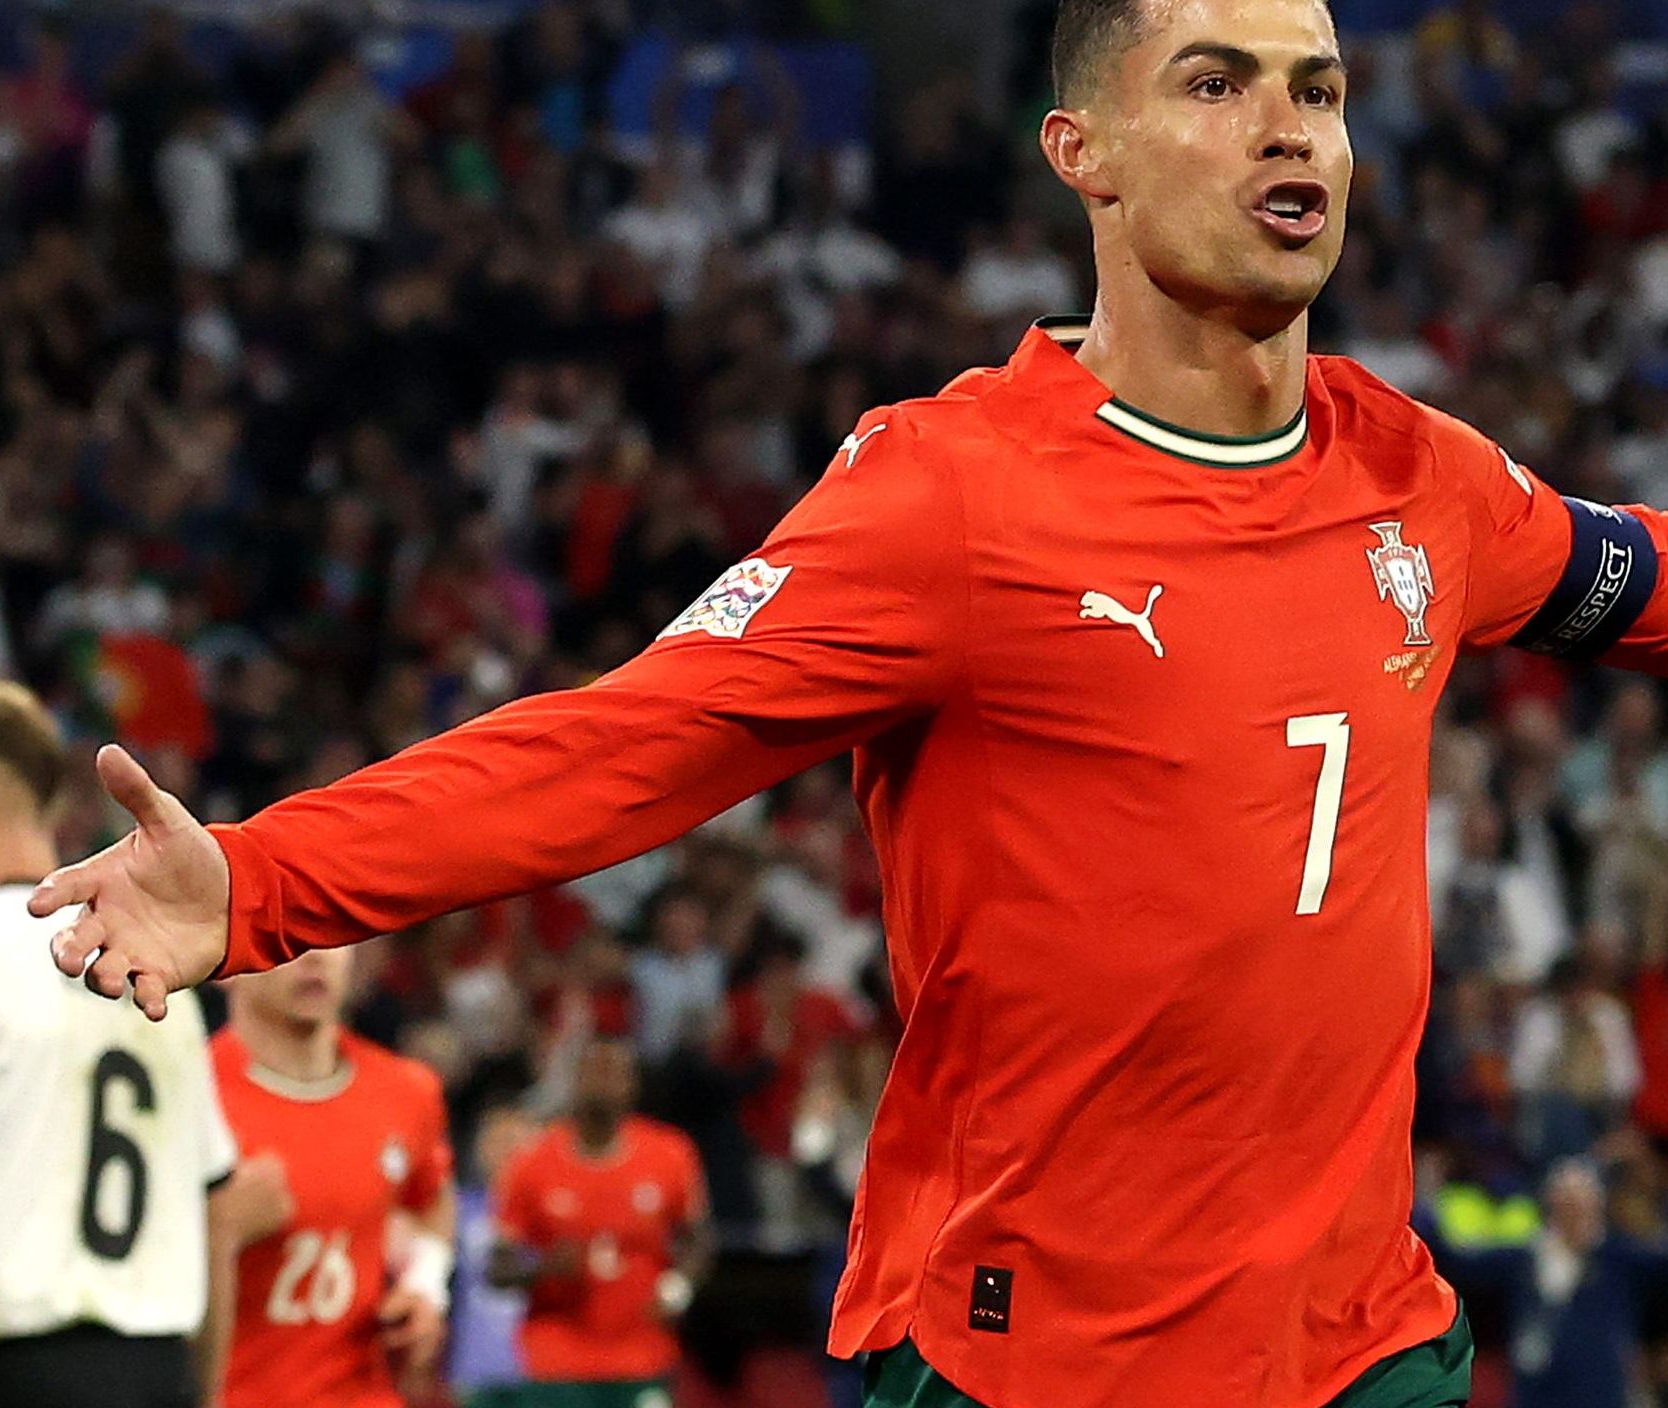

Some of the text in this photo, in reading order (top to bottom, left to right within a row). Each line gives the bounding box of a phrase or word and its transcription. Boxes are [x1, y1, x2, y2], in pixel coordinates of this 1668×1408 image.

[1558, 540, 1626, 641] RESPECT
[1286, 712, 1350, 915] 7
[79, 1048, 156, 1262] 6
[268, 1231, 358, 1325] 26
